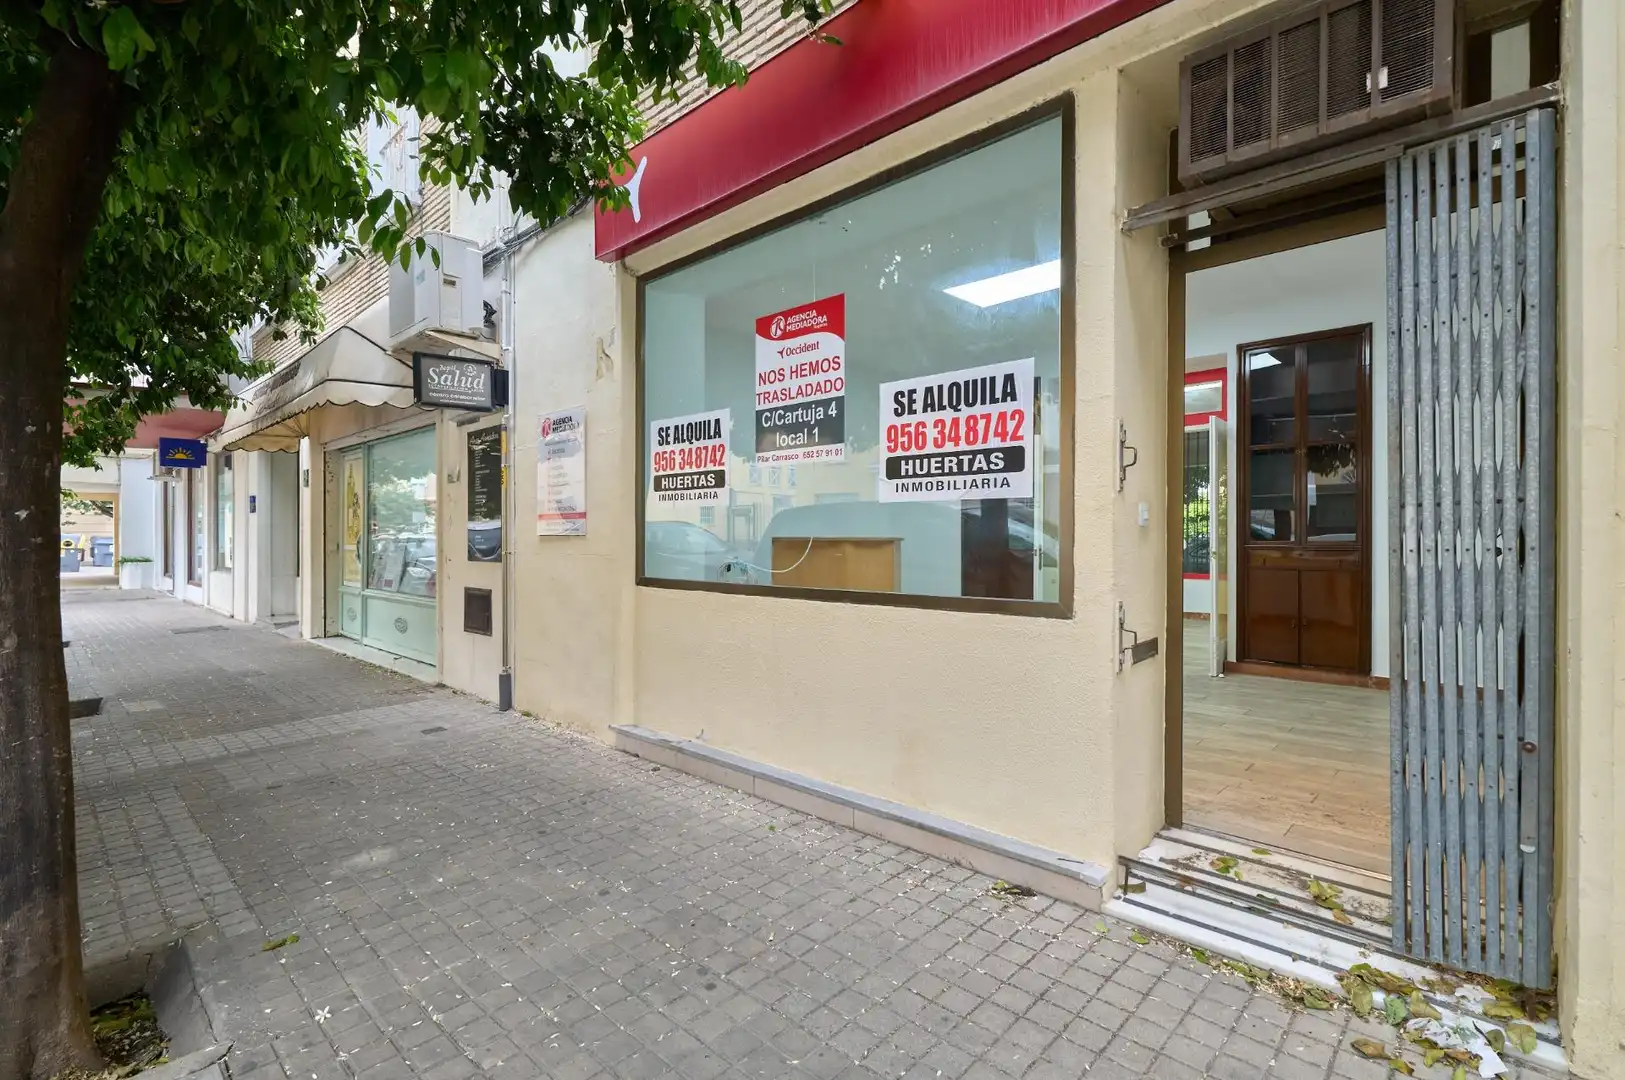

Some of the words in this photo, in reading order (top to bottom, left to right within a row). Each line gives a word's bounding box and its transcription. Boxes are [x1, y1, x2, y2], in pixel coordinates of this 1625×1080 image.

[786, 309, 817, 324] AGENCIA
[786, 315, 828, 332] MEDIADORA
[785, 341, 820, 357] Occident
[427, 367, 486, 390] Salud
[758, 367, 786, 387] NOS
[789, 355, 841, 380] HEMOS
[756, 377, 844, 406] TRASLADADO
[893, 388, 918, 418] SE
[922, 372, 1018, 412] ALQUILA
[762, 404, 824, 428] C/Cartuja
[828, 401, 837, 417] 4
[657, 426, 671, 446] SE
[673, 418, 722, 445] ALQUILA
[776, 428, 808, 448] local
[812, 426, 819, 443] 1
[886, 421, 928, 454] 956
[654, 449, 676, 473] 956
[771, 453, 799, 462] Carrasco
[802, 450, 814, 459] 652
[815, 449, 824, 457] 57
[825, 449, 833, 457] 91
[834, 448, 843, 456] 01
[900, 452, 1006, 476] HUERTAS
[661, 473, 716, 490] HUERTAS
[895, 476, 1011, 493] INMOBILIARIA
[658, 491, 719, 502] INMOBILIARIA
